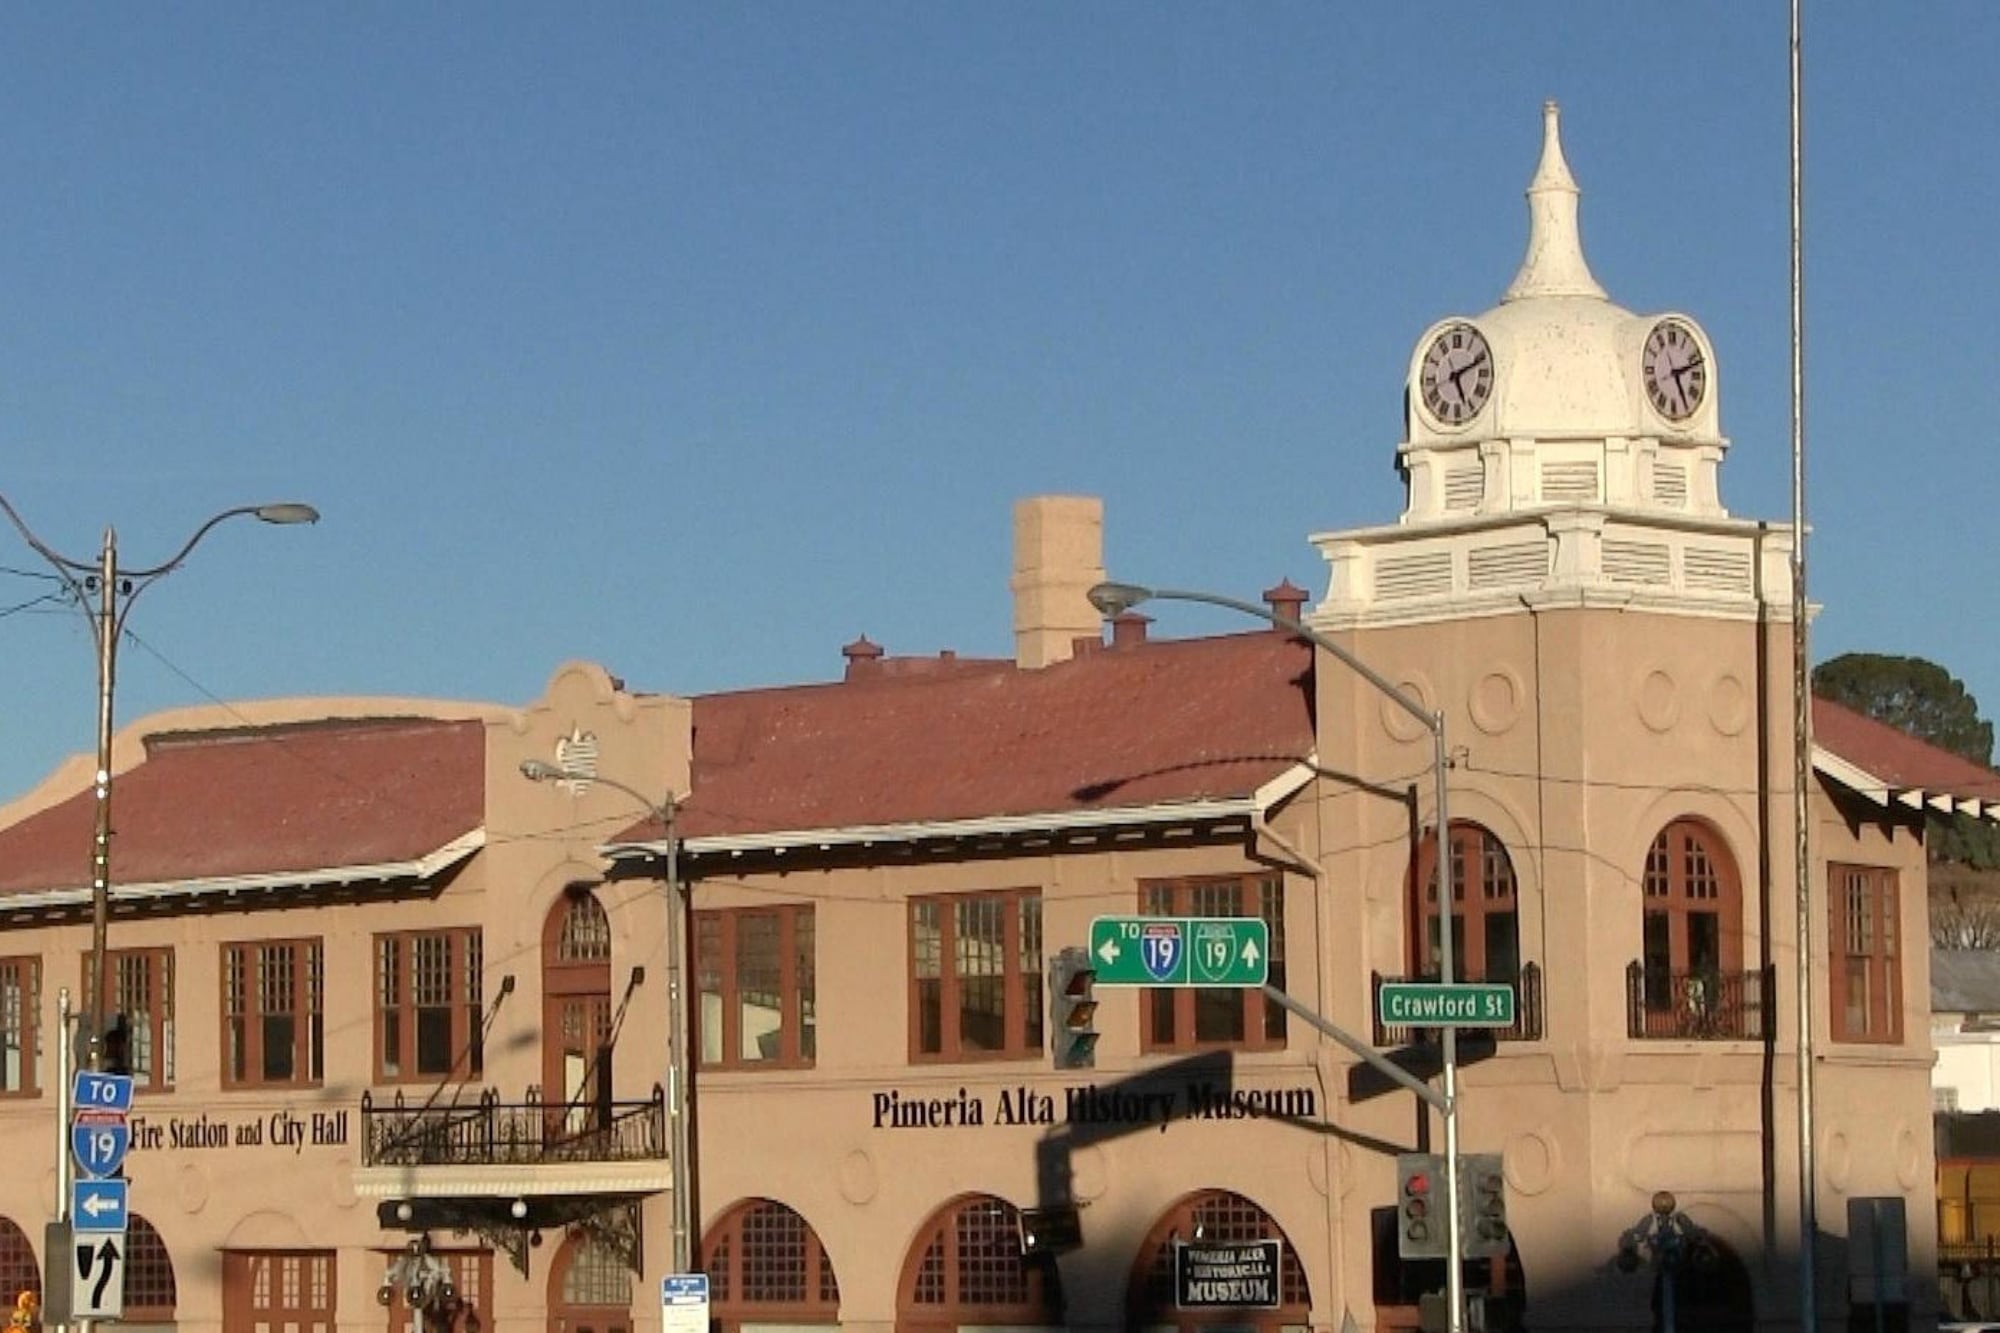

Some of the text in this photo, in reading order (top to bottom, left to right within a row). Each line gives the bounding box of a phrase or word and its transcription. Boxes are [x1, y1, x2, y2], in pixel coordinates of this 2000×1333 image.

[1119, 923, 1140, 939] TO
[1149, 938, 1174, 968] 19
[1206, 943, 1227, 968] 19
[1391, 994, 1503, 1016] Crawford St
[90, 1081, 116, 1103] TO
[872, 1083, 1317, 1134] Pimeria Alta History Museum
[128, 1109, 348, 1154] Fire Station and City Hall
[89, 1132, 116, 1164] 19
[1187, 1279, 1270, 1302] MUSEUM
